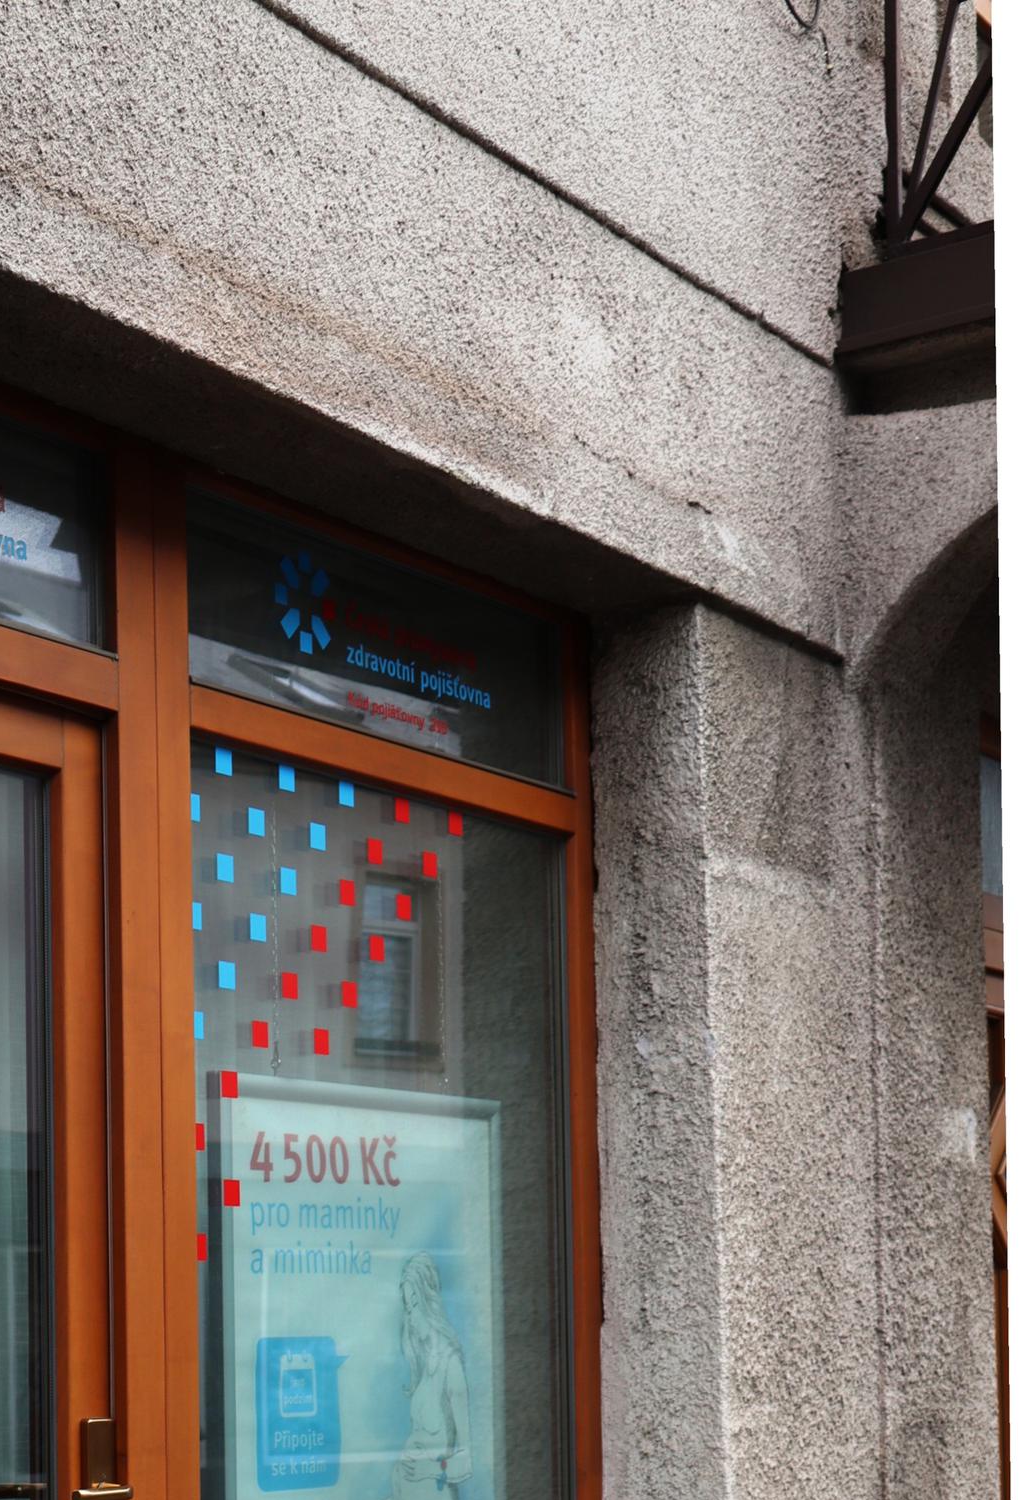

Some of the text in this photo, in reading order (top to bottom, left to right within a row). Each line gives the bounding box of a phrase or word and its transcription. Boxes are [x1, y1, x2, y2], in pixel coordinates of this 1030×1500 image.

[345, 643, 416, 685] zdravotní
[420, 670, 491, 710] pojišťovna
[250, 1131, 401, 1187] 4 500 Kč
[250, 1196, 401, 1239] pro maminky
[250, 1240, 373, 1275] a miminka
[273, 1428, 325, 1450] Připojte
[271, 1461, 287, 1477] se
